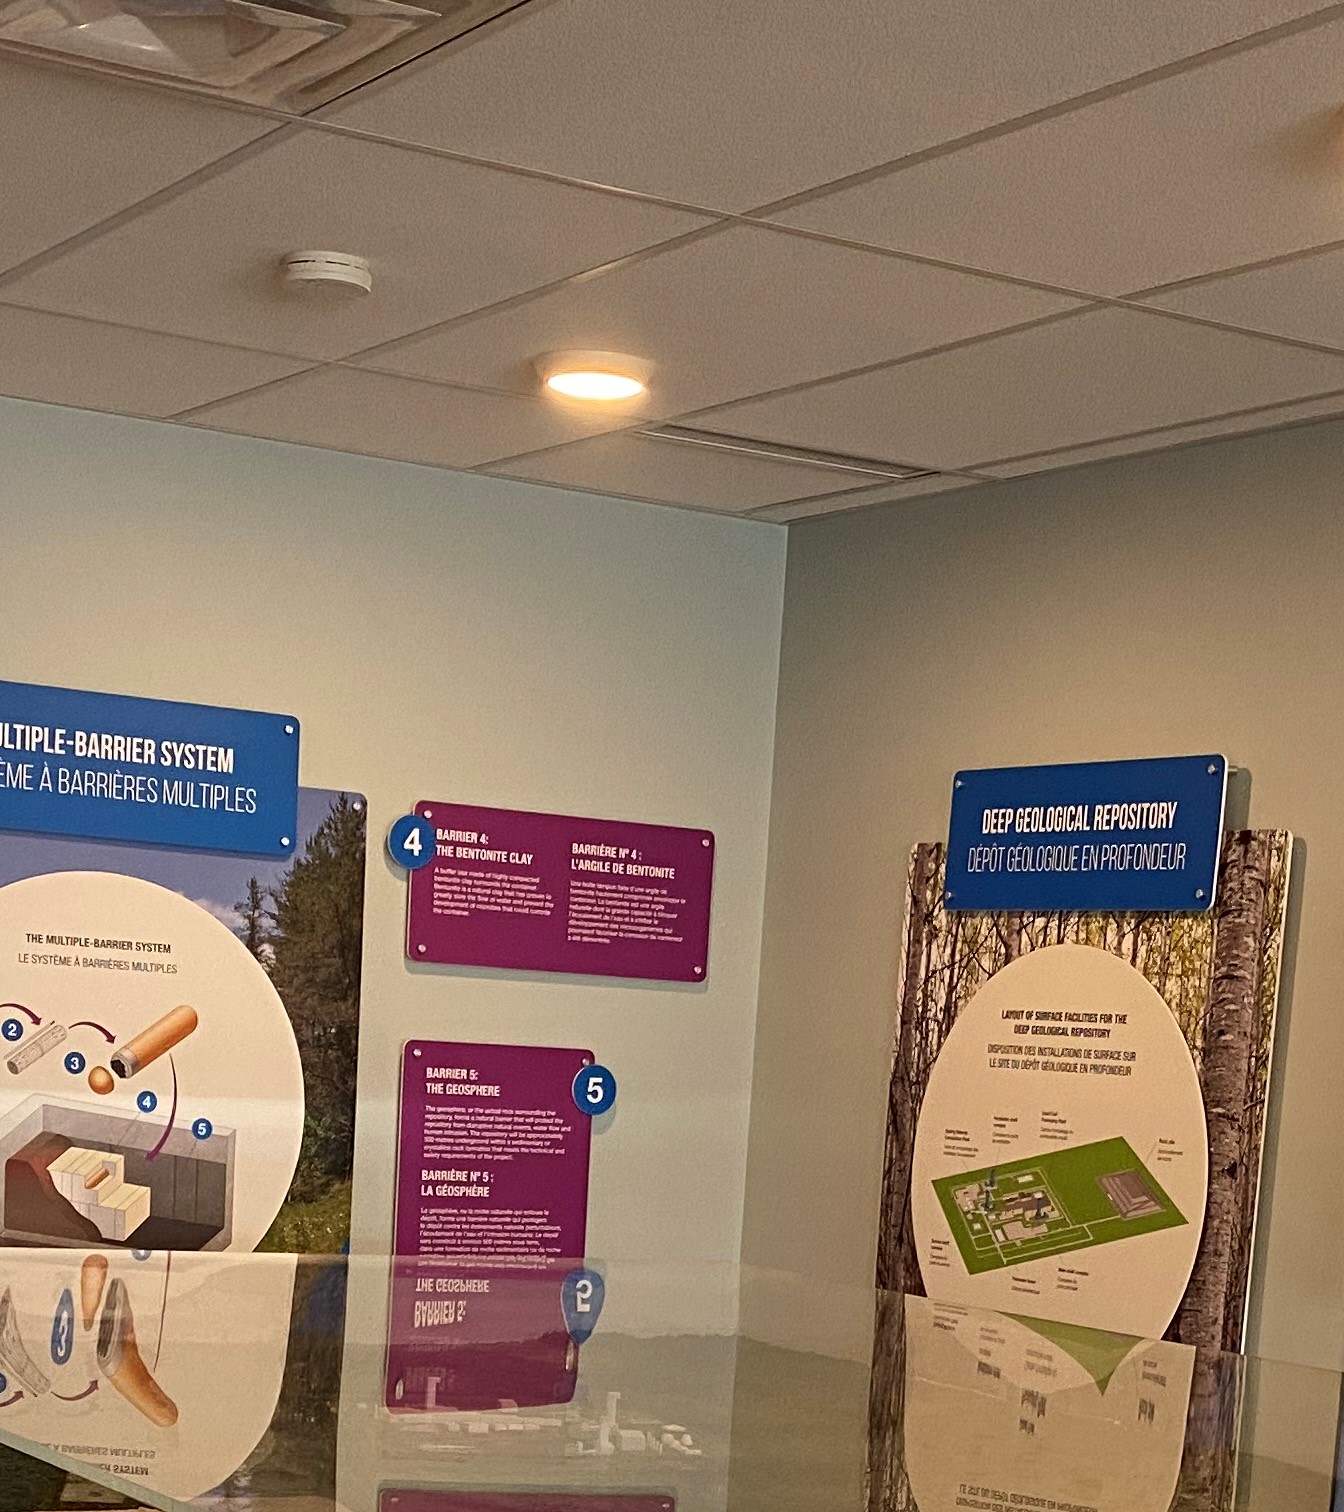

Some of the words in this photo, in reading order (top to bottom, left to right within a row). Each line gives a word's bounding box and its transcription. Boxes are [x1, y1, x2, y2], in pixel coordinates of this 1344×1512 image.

[160, 741, 233, 774] SYSTEM
[39, 763, 52, 792] À
[58, 768, 158, 803] BARRIÈRES
[163, 779, 256, 813] MULTIPLES
[982, 808, 1013, 834] DEEP
[1016, 805, 1090, 833] GEOLOGICAL
[1093, 802, 1177, 830] REPOSITORY
[404, 828, 422, 856] 4
[437, 828, 478, 843] BARRIER
[480, 834, 488, 844] 4:
[436, 845, 454, 857] THE
[456, 847, 508, 862] BENTONITE
[509, 852, 533, 865] CLAY
[572, 843, 617, 858] BARRIÈRE
[631, 849, 636, 860] 4
[968, 843, 1005, 872] DÉPÔT
[1007, 842, 1079, 872] GÉOLOGIQUE
[1081, 845, 1099, 871] EN
[1100, 843, 1186, 870] PROFONDEUR
[612, 863, 624, 874] DE
[626, 864, 675, 879] BENTONITE
[26, 933, 43, 943] THE
[46, 935, 132, 950] MULTIPLE-BARRIER
[135, 942, 171, 953] SYSTEM
[19, 953, 29, 963] LE
[31, 954, 72, 966] SYSTÈME
[74, 956, 80, 966] À
[83, 958, 129, 970] BARRIÈRES
[132, 962, 177, 974] MULTIPLES
[8, 1023, 17, 1036] 2
[71, 1057, 79, 1070] 3
[426, 1067, 467, 1079] BARRIER
[469, 1069, 478, 1080] 5:
[426, 1083, 444, 1094] THE
[446, 1084, 500, 1096] GEOSPHERE
[587, 1077, 603, 1103] 5
[142, 1096, 151, 1108] 4
[198, 1123, 206, 1135] 5
[422, 1168, 468, 1181] BARRIÈRE
[483, 1172, 489, 1182] 5
[421, 1185, 433, 1196] LA
[436, 1184, 489, 1197] GÉOSPHÈRE
